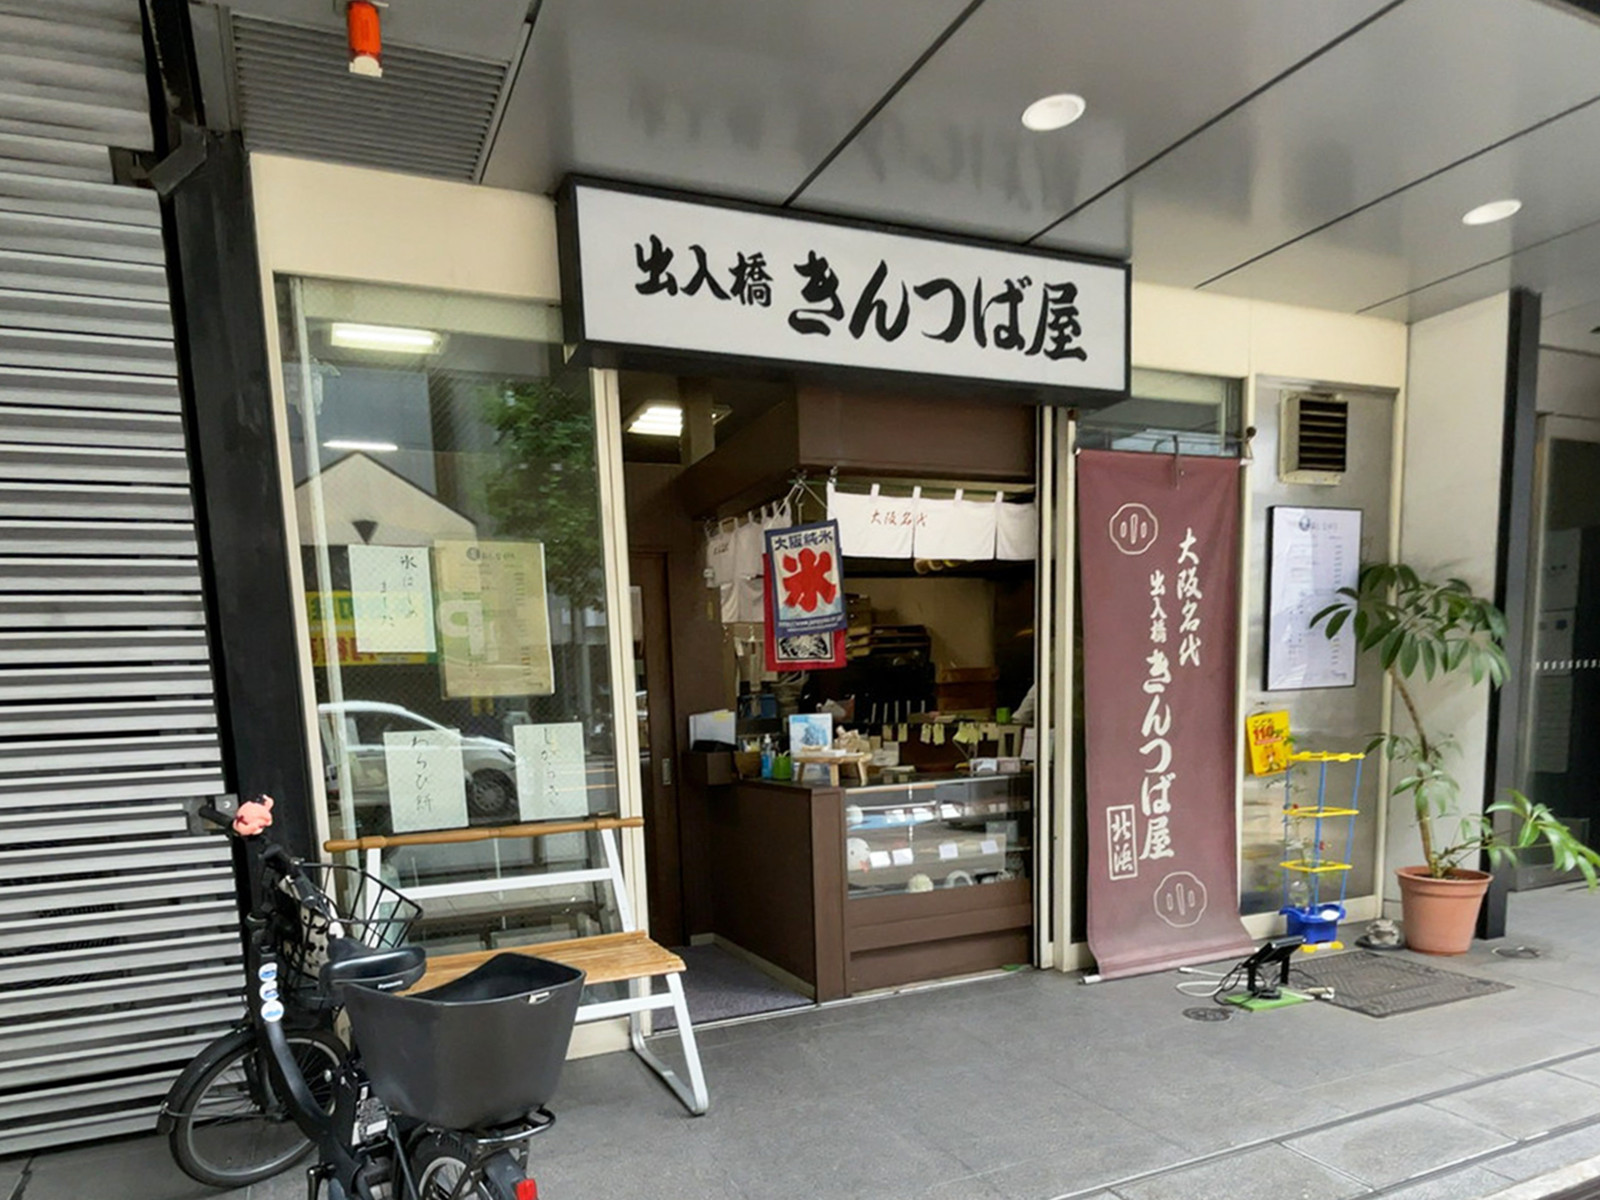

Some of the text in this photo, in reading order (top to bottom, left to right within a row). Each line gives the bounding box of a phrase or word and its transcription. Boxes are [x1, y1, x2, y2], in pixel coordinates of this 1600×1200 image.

[634, 234, 1088, 362] 出入橋 きんつば屋
[774, 529, 834, 552] 大阪純氷
[871, 510, 929, 527] 大阪名代
[782, 547, 837, 613] 氷
[1176, 526, 1203, 669] 大阪名代
[1138, 569, 1176, 861] 出入橋 きんつば屋
[1111, 811, 1135, 874] 北浜
